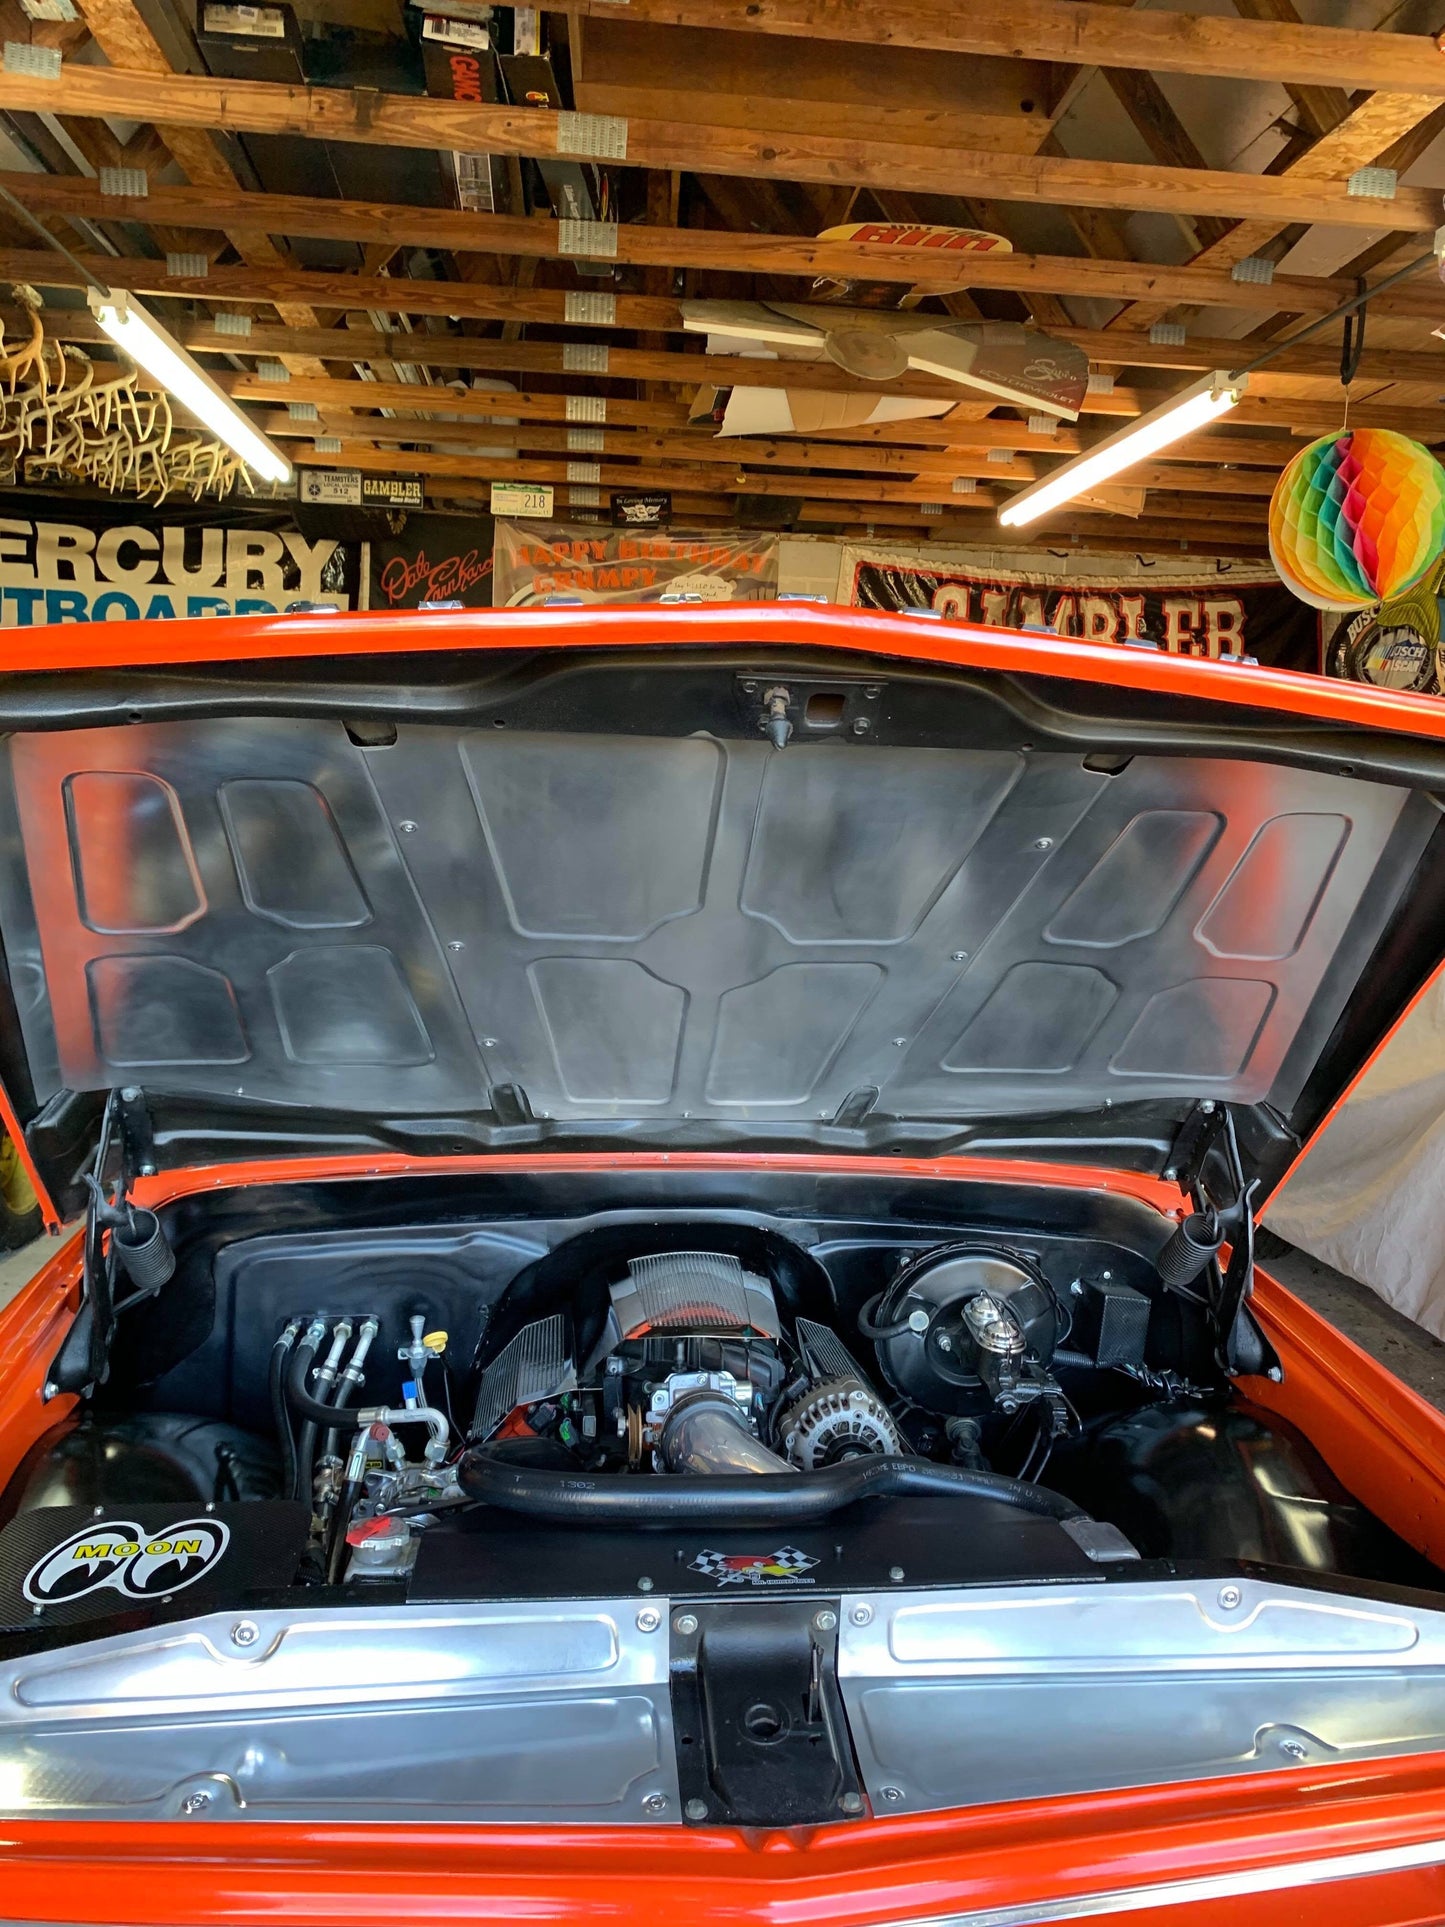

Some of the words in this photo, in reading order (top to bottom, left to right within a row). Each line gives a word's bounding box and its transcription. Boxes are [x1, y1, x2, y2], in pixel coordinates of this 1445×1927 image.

[363, 479, 421, 497] GAMBLER
[524, 493, 546, 509] 218
[381, 550, 430, 605] Dale
[532, 567, 658, 594] GRUMPY
[1346, 603, 1384, 645] BUSC
[73, 1538, 204, 1560] MOON
